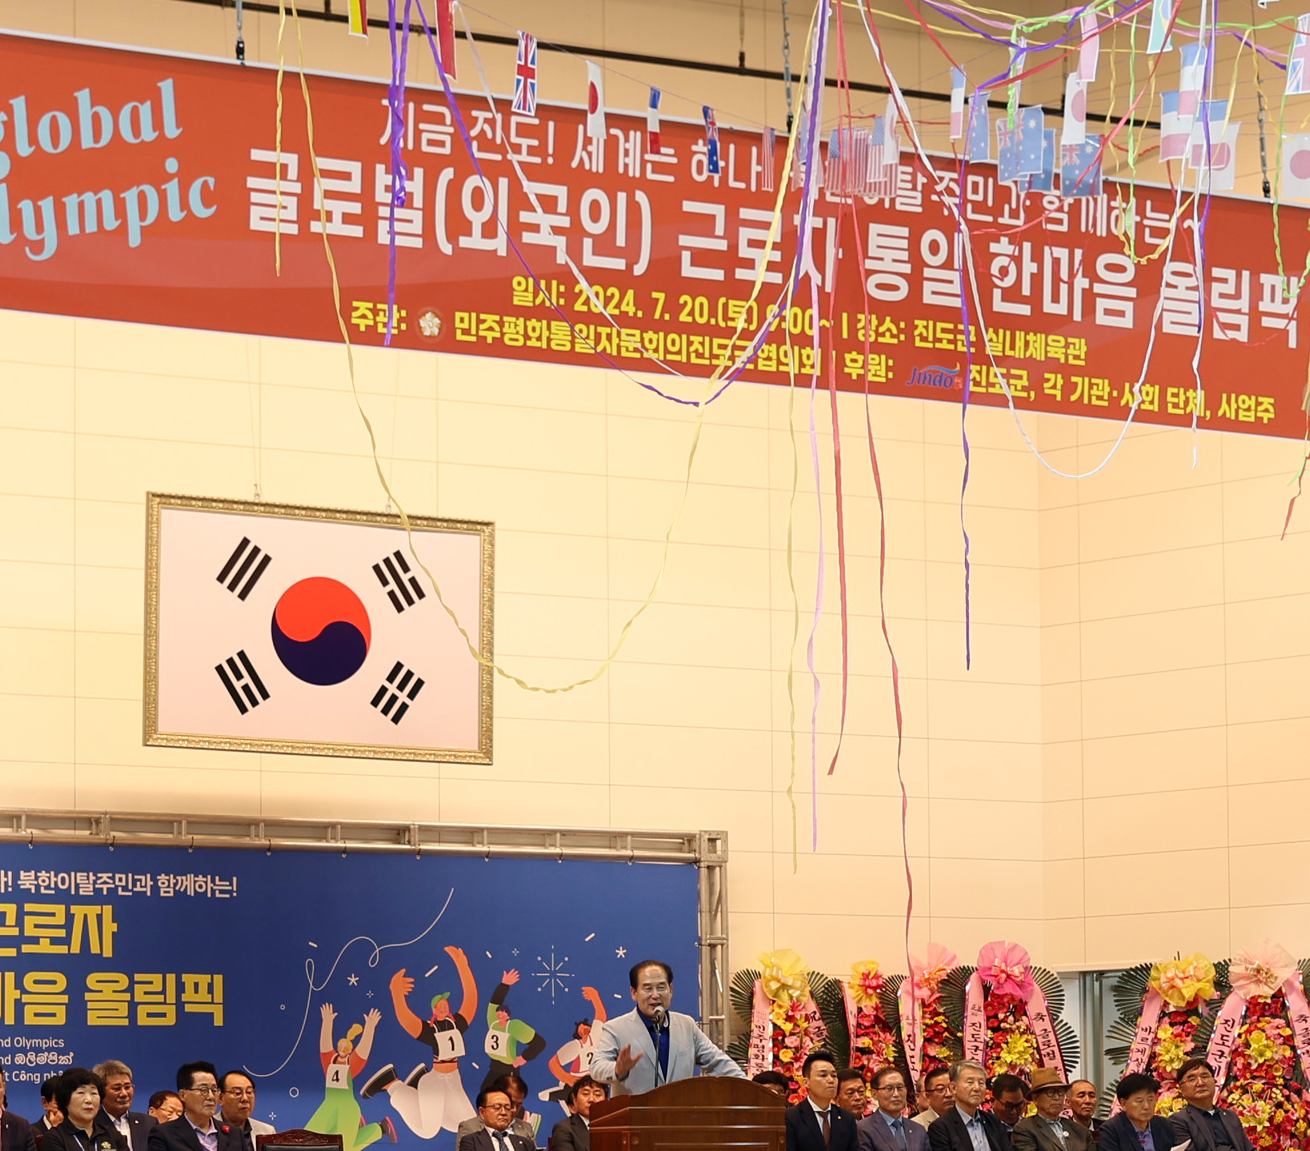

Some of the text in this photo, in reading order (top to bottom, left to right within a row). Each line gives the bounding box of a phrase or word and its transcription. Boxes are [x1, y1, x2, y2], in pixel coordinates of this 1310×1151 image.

[380, 99, 455, 154] 지금
[470, 110, 555, 164] 진도!
[572, 124, 677, 182] 세계는
[245, 148, 1299, 345] 글로벌(외국인) 근로자 통일 한마음 올림픽
[350, 299, 407, 335] 주관:
[512, 275, 566, 309] 일시:
[574, 282, 643, 318] 2024.
[652, 292, 671, 321] 7.
[678, 295, 758, 331] 20.(토)
[856, 314, 905, 347] 장소:
[914, 322, 976, 353] 진도군
[985, 327, 1087, 367] 실내체육관
[844, 351, 893, 384] 후원:
[969, 366, 1035, 400] 진도군,
[1042, 373, 1063, 400] 각
[1217, 392, 1275, 424] 사업주
[17, 870, 153, 897] 북한이탈주민과
[157, 873, 238, 898] 함께하는!
[85, 971, 224, 1026] 올림픽
[14, 1036, 65, 1050] Olympics
[448, 1035, 456, 1052] 1
[490, 1034, 500, 1051] 3
[331, 1069, 340, 1085] 4
